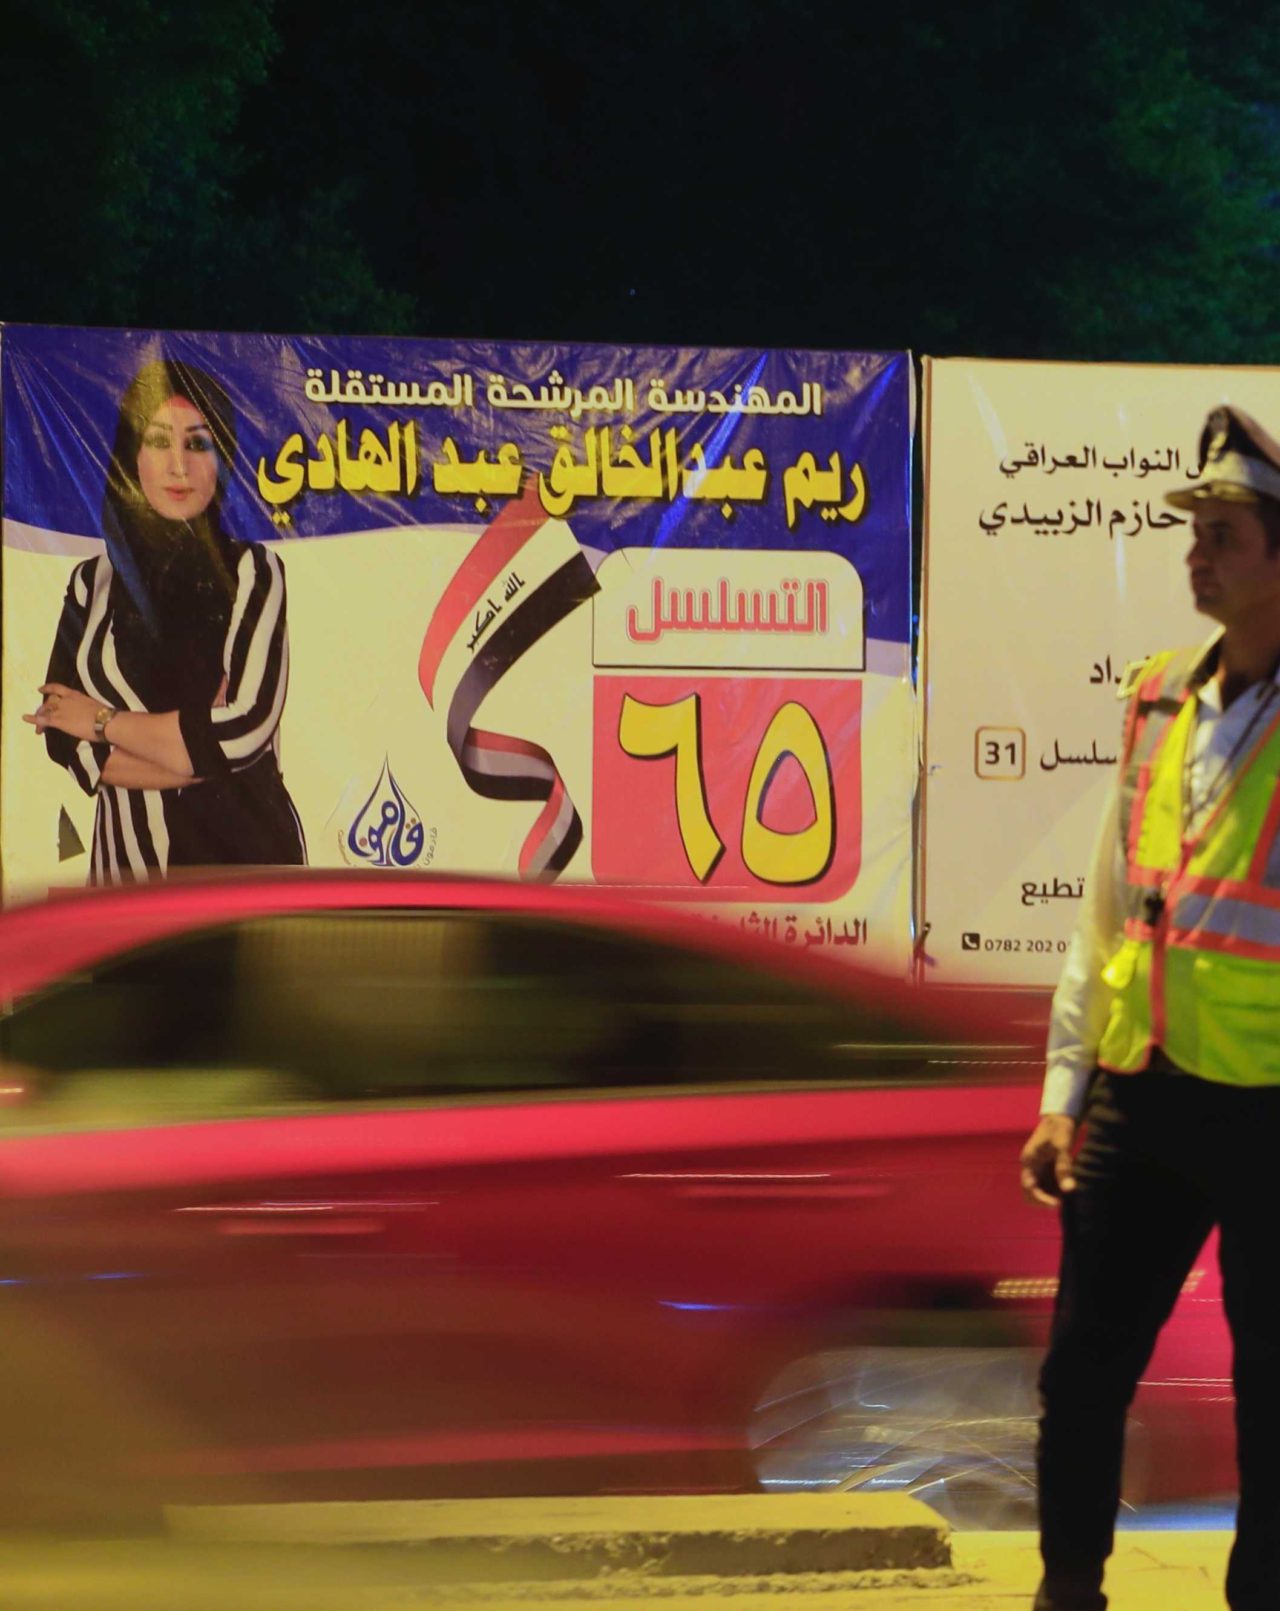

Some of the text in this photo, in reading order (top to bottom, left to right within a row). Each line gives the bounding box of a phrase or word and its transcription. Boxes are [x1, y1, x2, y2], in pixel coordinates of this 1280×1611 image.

[304, 367, 823, 419] المهندسة المرشحة المستقلة
[256, 417, 418, 527] الهادي
[432, 434, 526, 514] عبد
[1000, 443, 1097, 479] العراقي
[1103, 446, 1180, 481] النواب
[783, 448, 870, 530] ريم
[979, 498, 1188, 538] حازم الزبيدي
[626, 576, 828, 643] التسلسل
[985, 741, 1016, 765] 31
[618, 692, 838, 888] ٦٥
[784, 906, 868, 951] الدائرة
[984, 939, 1021, 952] 0782
[1026, 940, 1054, 953] 202
